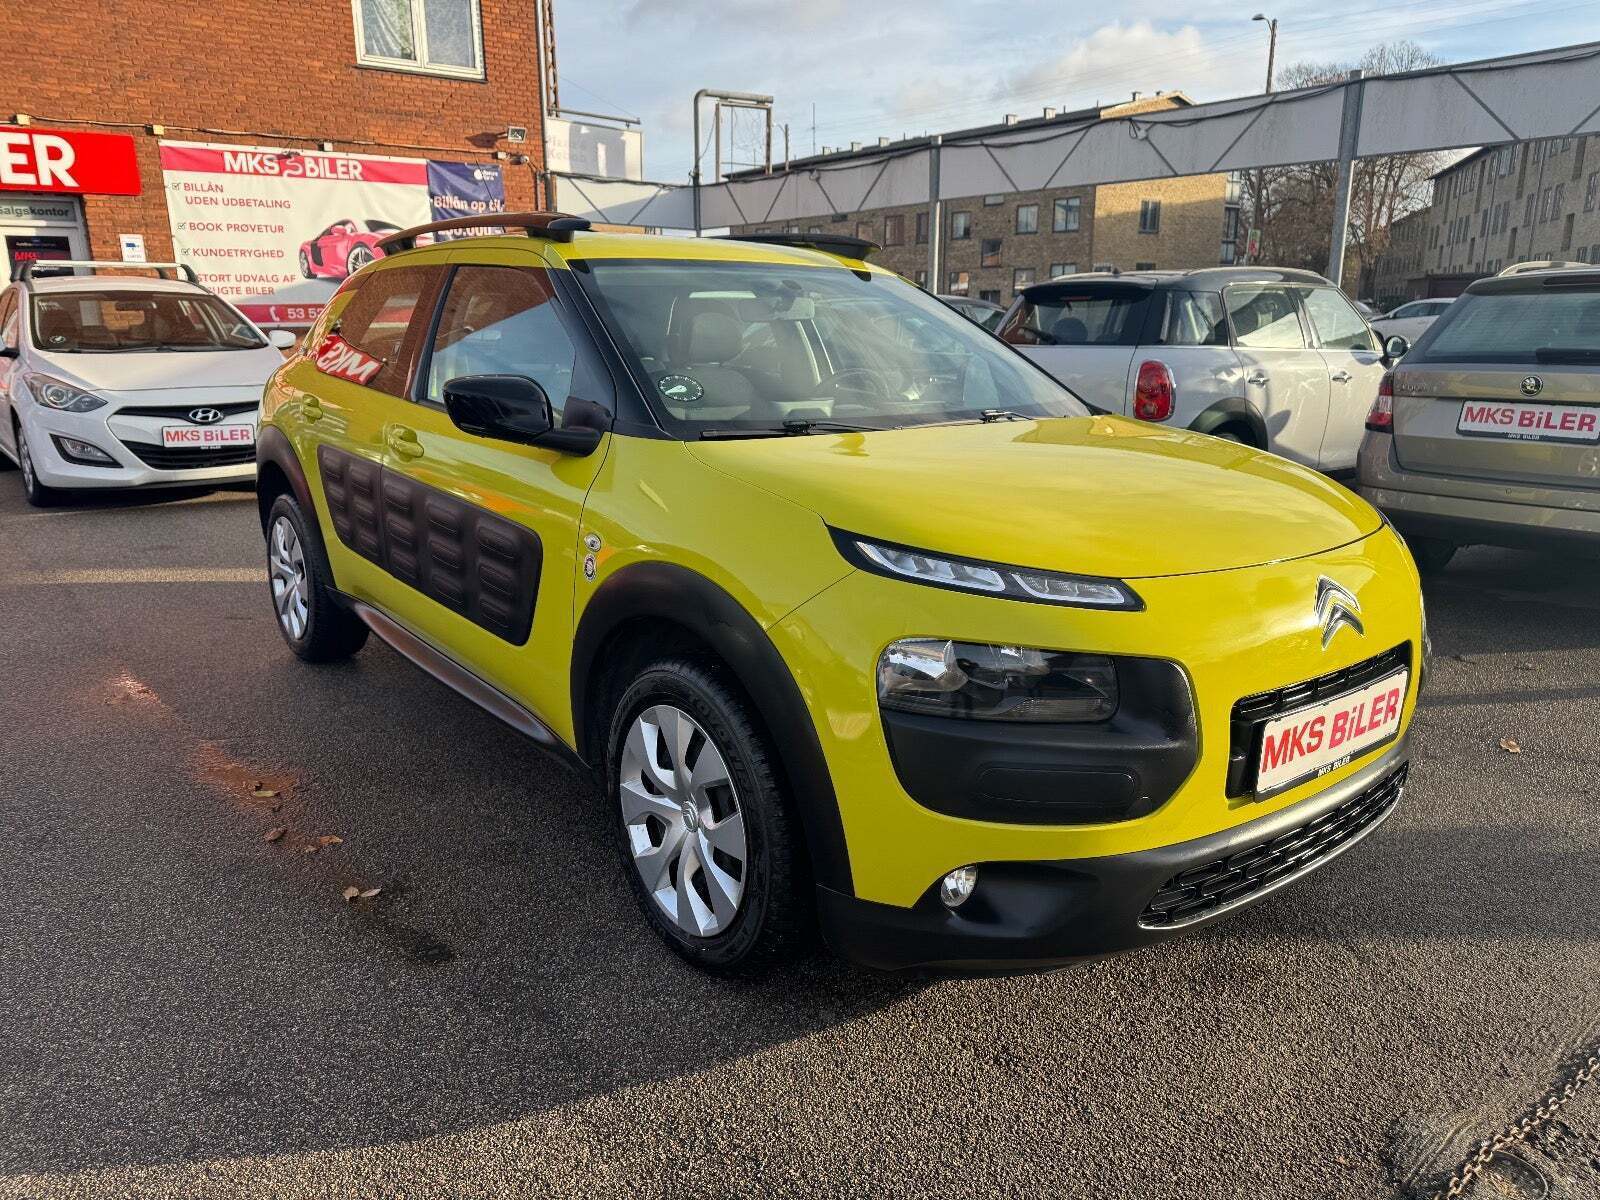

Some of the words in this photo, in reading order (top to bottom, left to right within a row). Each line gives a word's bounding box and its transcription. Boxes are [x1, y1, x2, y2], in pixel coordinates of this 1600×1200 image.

[223, 151, 281, 175] MKS
[303, 156, 363, 181] BILER
[183, 182, 224, 193] BILLÅN
[185, 196, 218, 206] UDEN
[222, 197, 291, 209] UDBETALING
[433, 195, 469, 210] Billån
[470, 200, 487, 214] op
[189, 222, 223, 232] BOOK
[226, 223, 284, 233] PRØVETUR
[192, 248, 284, 258] KUNDETRYGHED
[197, 273, 232, 283] STORT
[235, 274, 279, 283] UDVALG
[282, 274, 297, 283] AF
[245, 286, 275, 295] BILER
[287, 308, 305, 319] 53
[1463, 406, 1515, 425] MKS
[1518, 410, 1597, 432] BiLER
[165, 430, 200, 442] MKS
[203, 429, 250, 442] BiLER
[1261, 715, 1326, 773] MKS
[1328, 687, 1400, 750] BiLER
